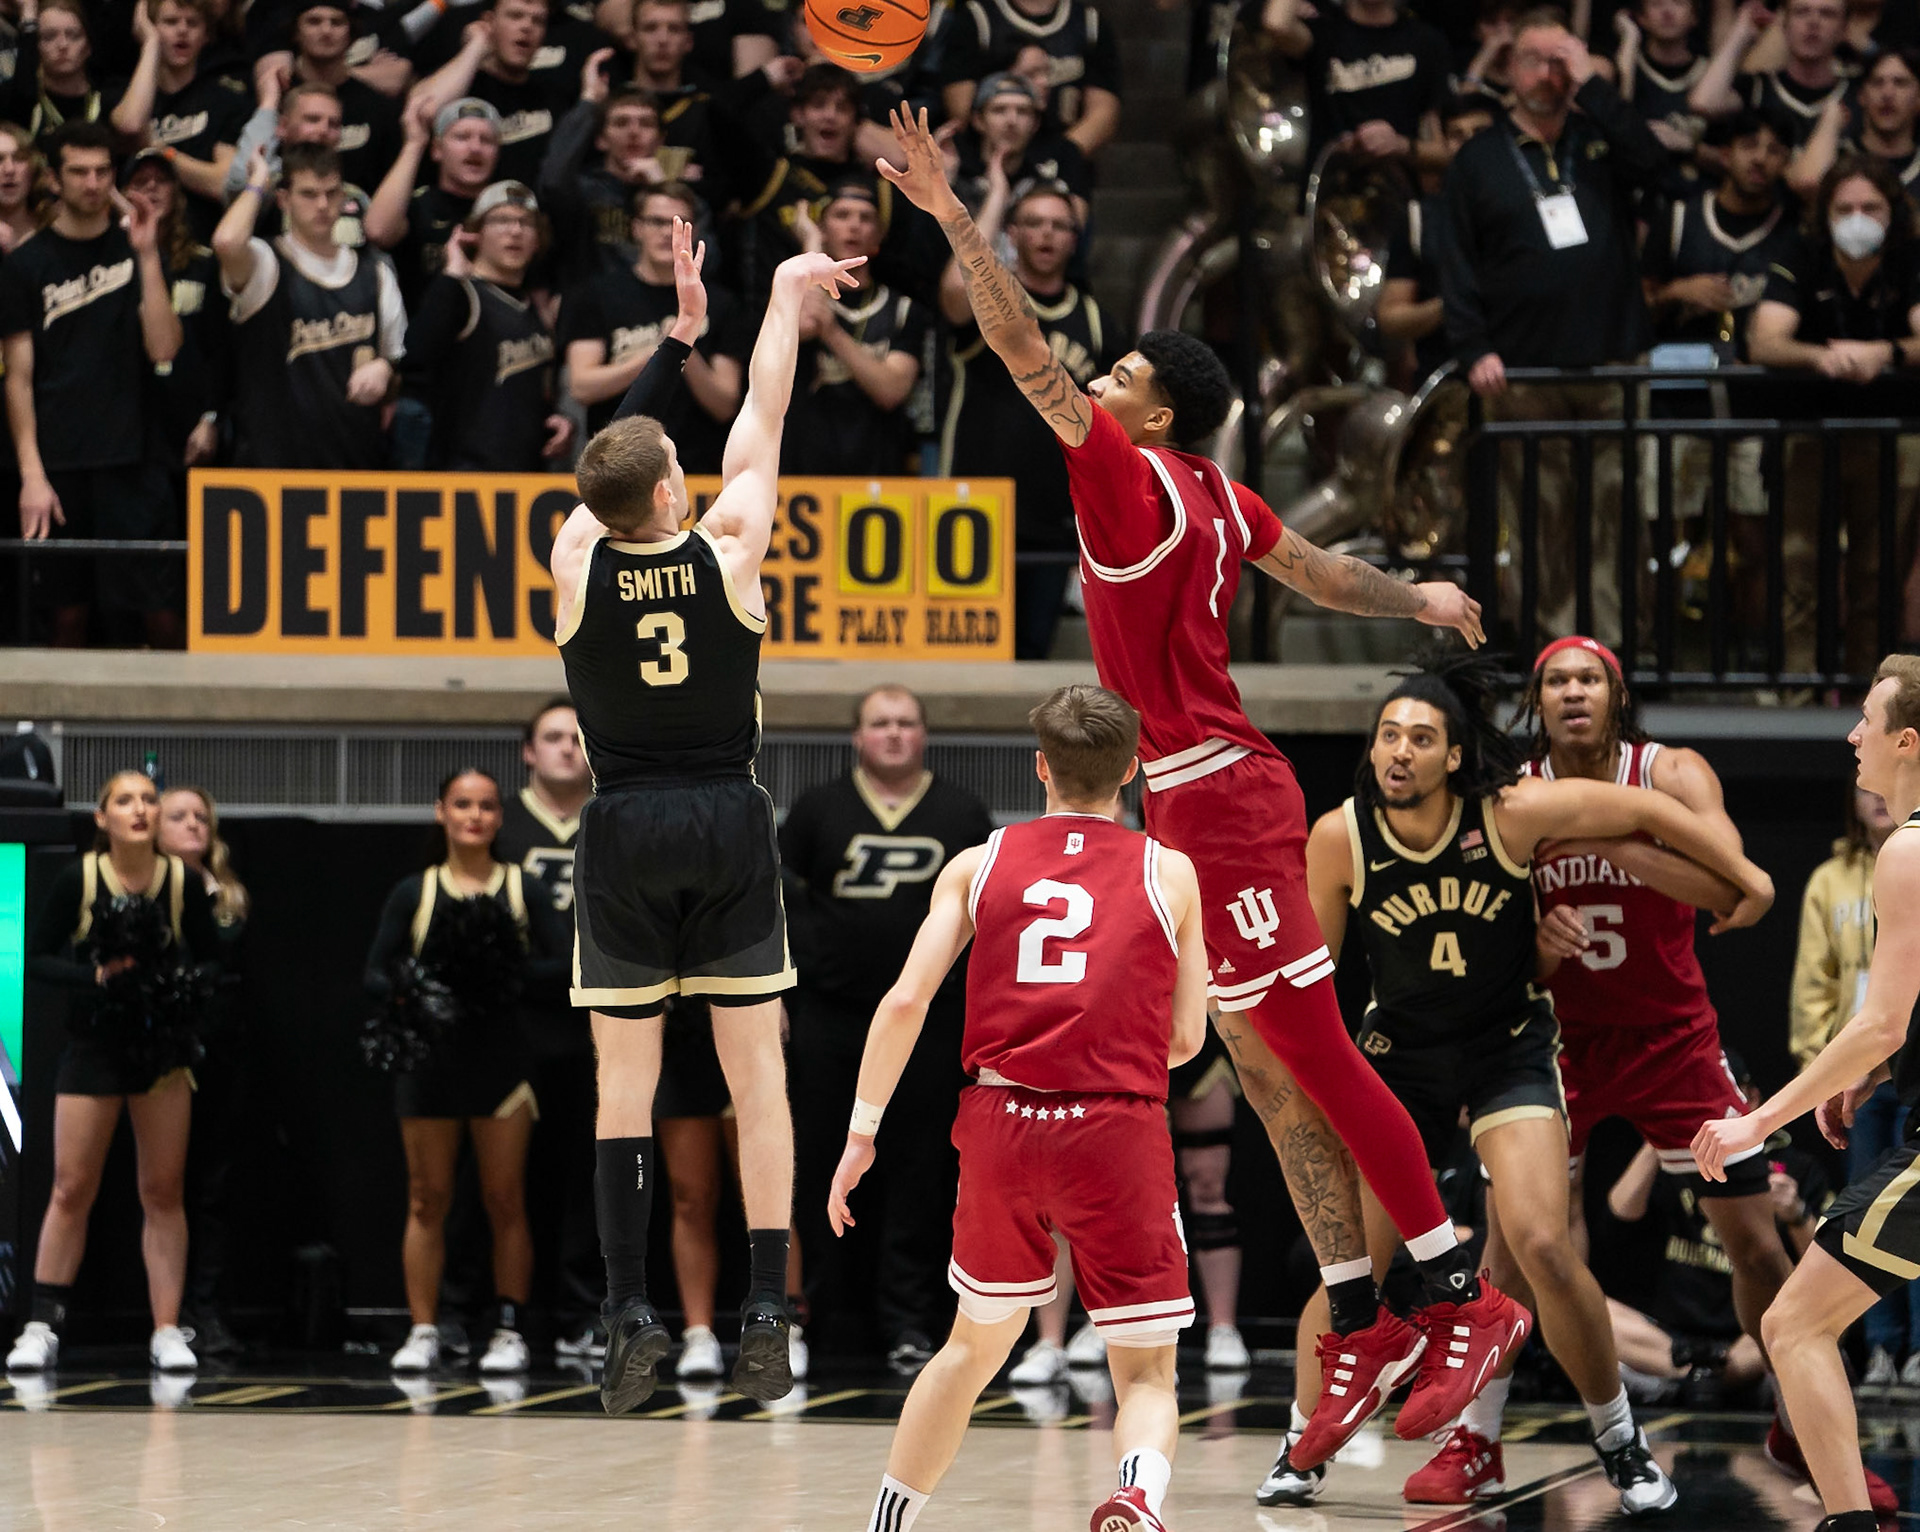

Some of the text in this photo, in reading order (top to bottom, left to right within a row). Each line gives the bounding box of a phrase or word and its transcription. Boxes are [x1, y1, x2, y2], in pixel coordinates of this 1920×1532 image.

[203, 486, 583, 642] DEFENS
[848, 507, 903, 586] 0
[936, 508, 991, 586] 0
[1209, 518, 1227, 618] 1
[617, 563, 697, 601] SMITH
[759, 574, 820, 643] RE
[636, 611, 689, 687] 3
[839, 608, 1000, 645] PLAY HARD
[833, 834, 945, 899] P
[1536, 854, 1642, 893] INDIA
[1016, 878, 1095, 983] 2
[1370, 877, 1512, 937] PURDUE
[1579, 904, 1627, 971] 5
[1430, 931, 1467, 977] 4
